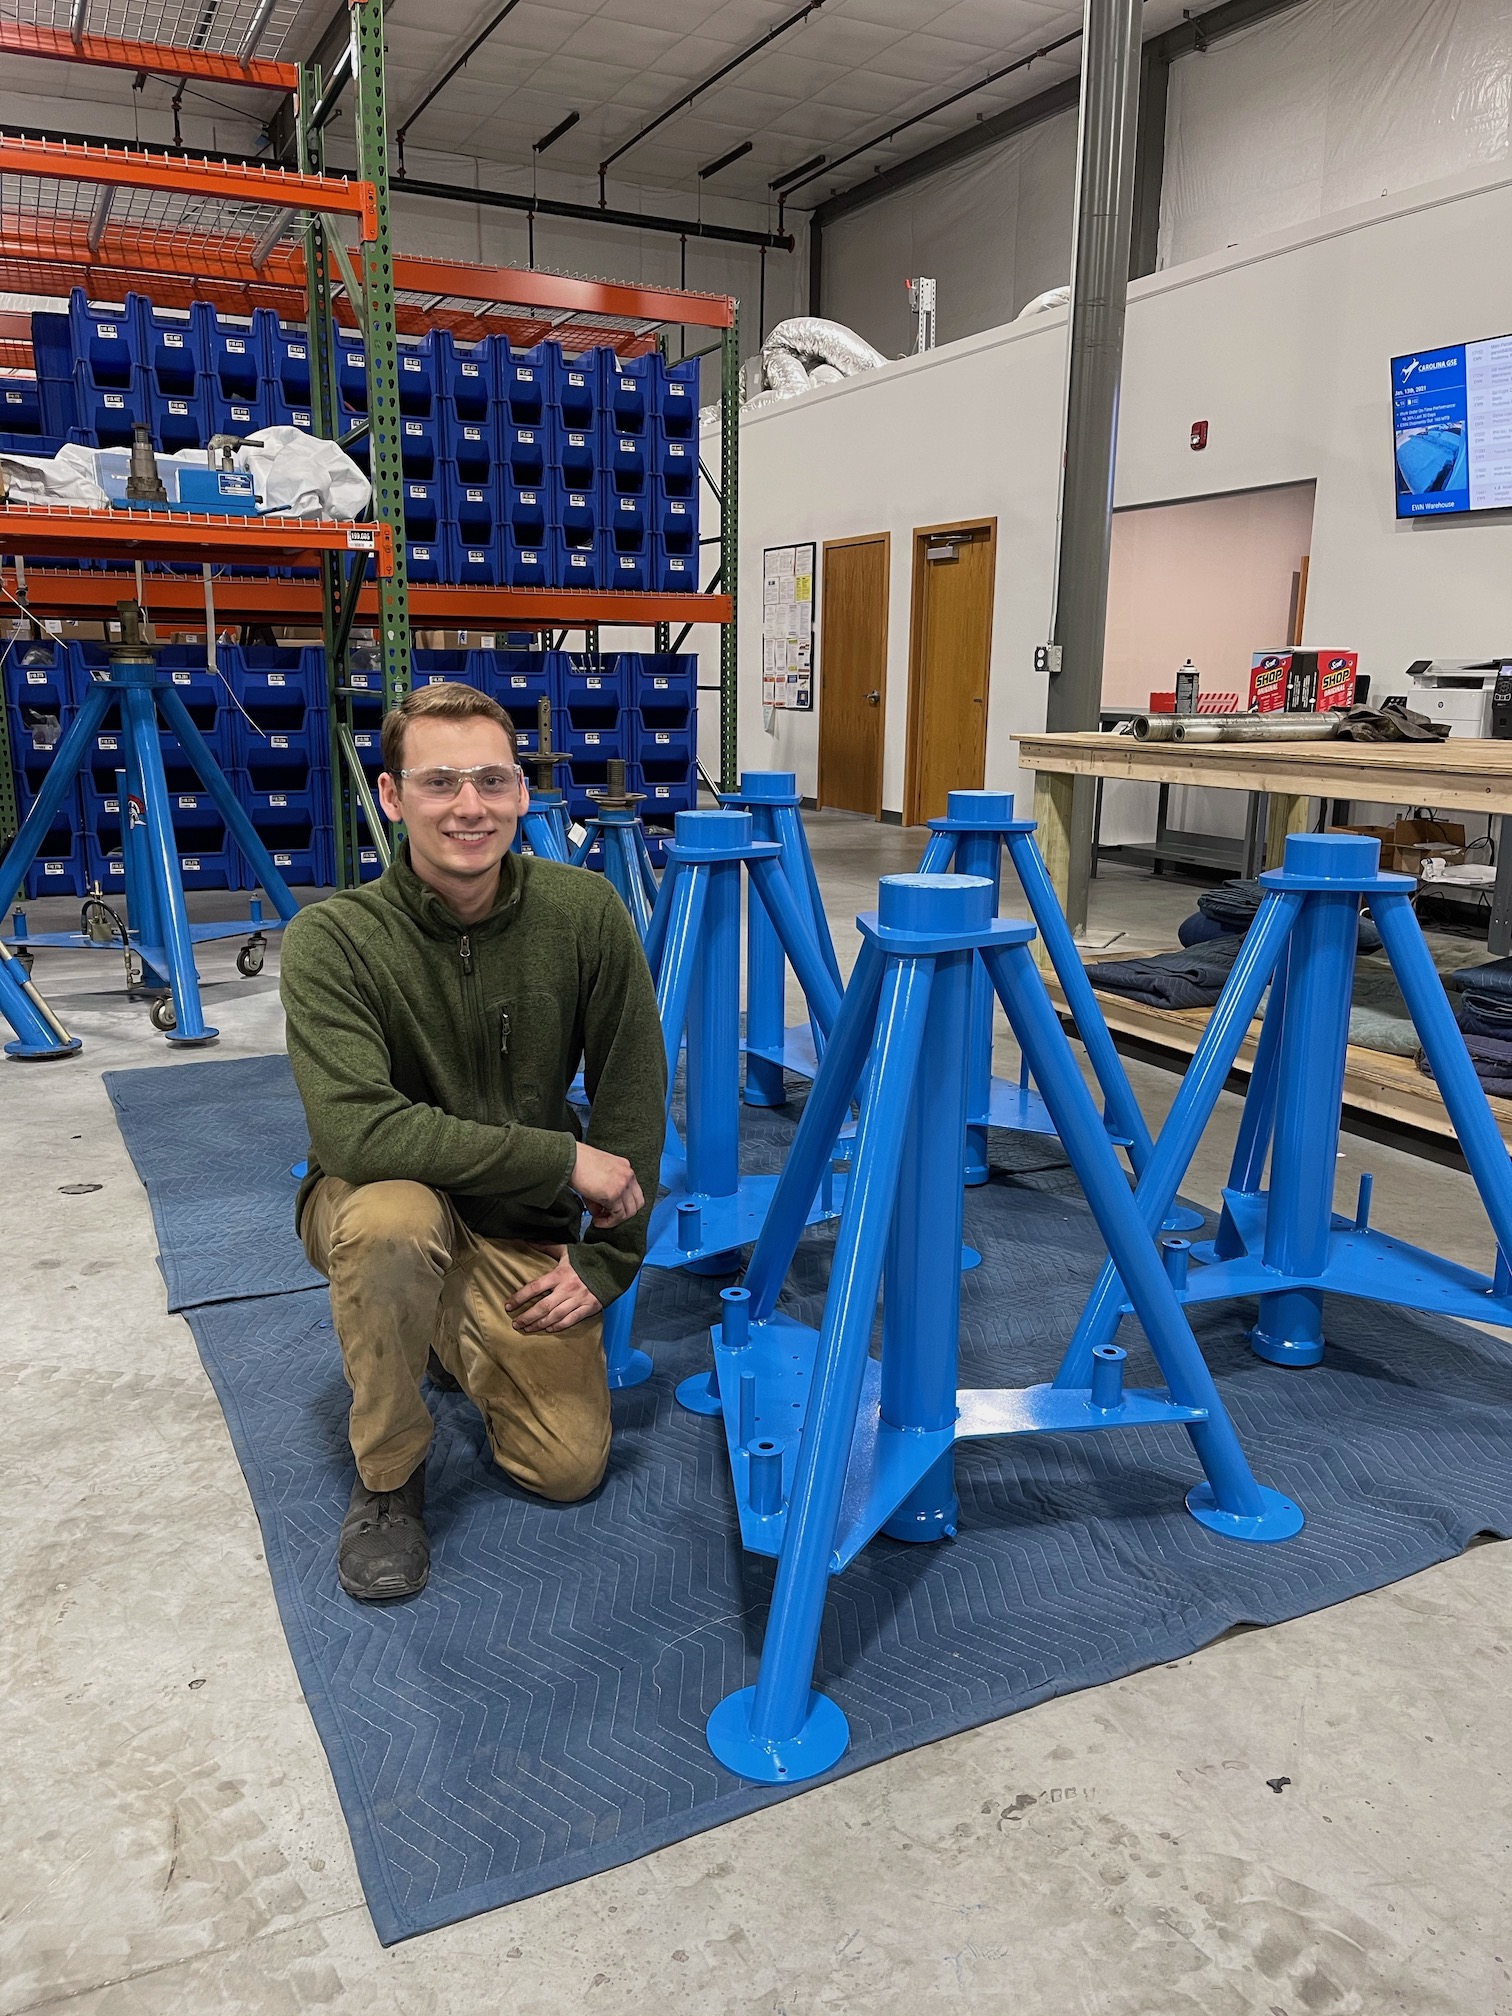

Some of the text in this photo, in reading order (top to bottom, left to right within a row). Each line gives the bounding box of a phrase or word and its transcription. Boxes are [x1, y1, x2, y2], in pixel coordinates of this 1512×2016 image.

[1418, 358, 1458, 373] CAROLINA GSE
[1415, 385, 1427, 393] 2021
[1411, 501, 1455, 512] EWN Warehouse
[1256, 668, 1283, 688] SHOP
[1322, 669, 1350, 689] SHOP
[1256, 683, 1279, 696] ORIGINAL
[1323, 684, 1345, 697] ORIGINAL
